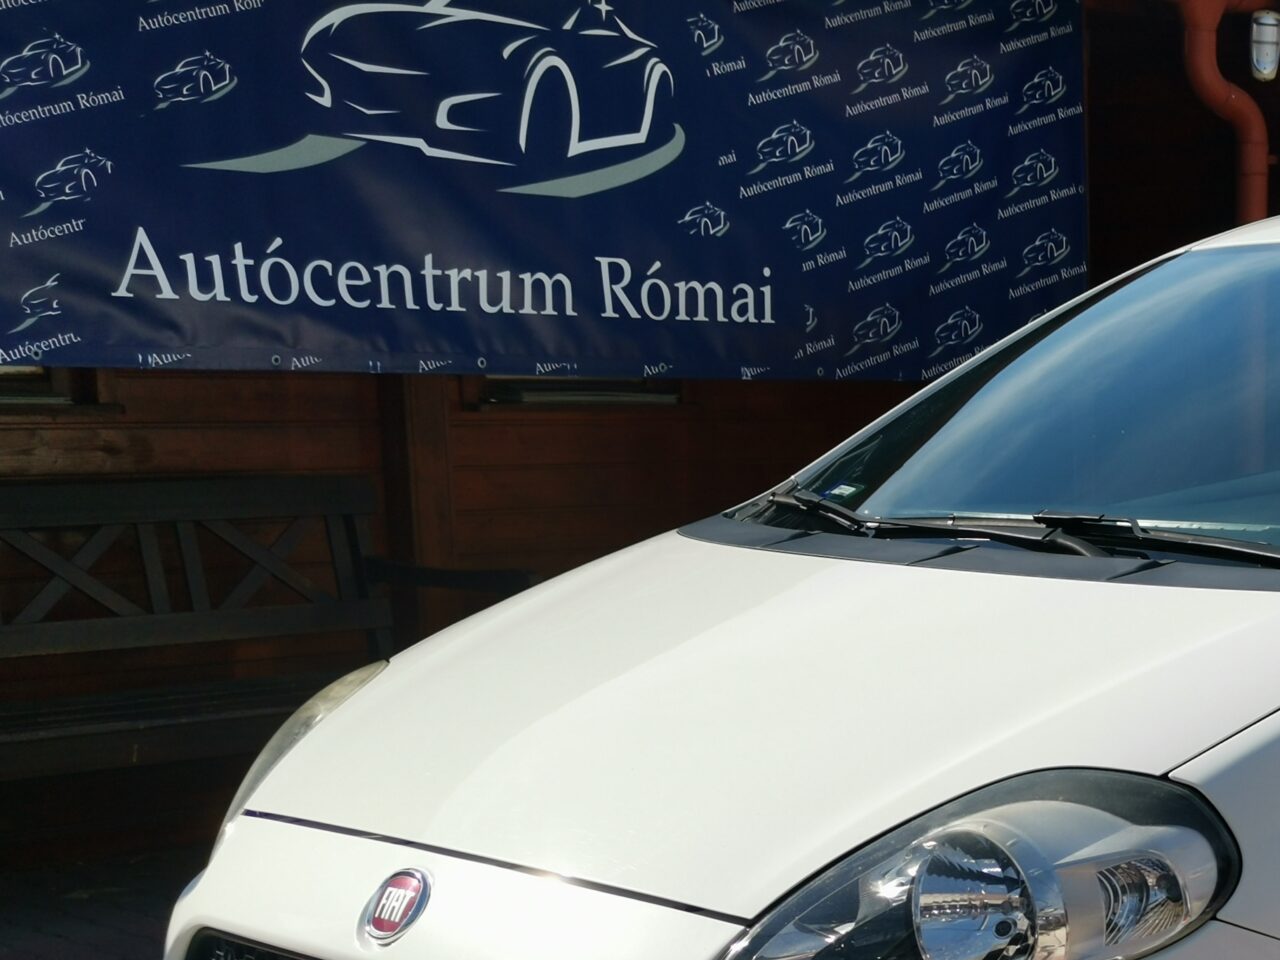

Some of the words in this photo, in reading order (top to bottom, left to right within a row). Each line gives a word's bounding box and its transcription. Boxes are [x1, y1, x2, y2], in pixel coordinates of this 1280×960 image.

[138, 2, 230, 32] Autócentrum
[825, 6, 882, 29] Autócentrum
[913, 17, 967, 42] Autócentrum
[968, 10, 995, 27] Római
[712, 56, 746, 76] Római
[0, 104, 75, 127] tócentrum
[77, 86, 125, 108] Római
[747, 80, 811, 106] Autócentrum
[812, 70, 841, 89] Római
[845, 93, 900, 117] Autócentrum
[901, 82, 929, 101] Római
[738, 171, 802, 199] Autócentrum
[803, 160, 834, 179] Római
[835, 182, 893, 207] Autócentrum
[894, 168, 923, 188] Római
[111, 226, 578, 317] Autócentrum
[594, 256, 775, 324] Római
[816, 246, 847, 267] Római
[847, 264, 902, 293] Autócentrum
[903, 252, 931, 272] Római
[928, 270, 981, 296] Autócentrum
[981, 257, 1007, 276] Római
[1008, 271, 1059, 300] Autócentrum
[1060, 261, 1087, 280] Római
[805, 334, 835, 356] Római
[834, 350, 891, 380] Autócentrum
[892, 337, 920, 358] Római
[374, 886, 417, 923] FIAT
